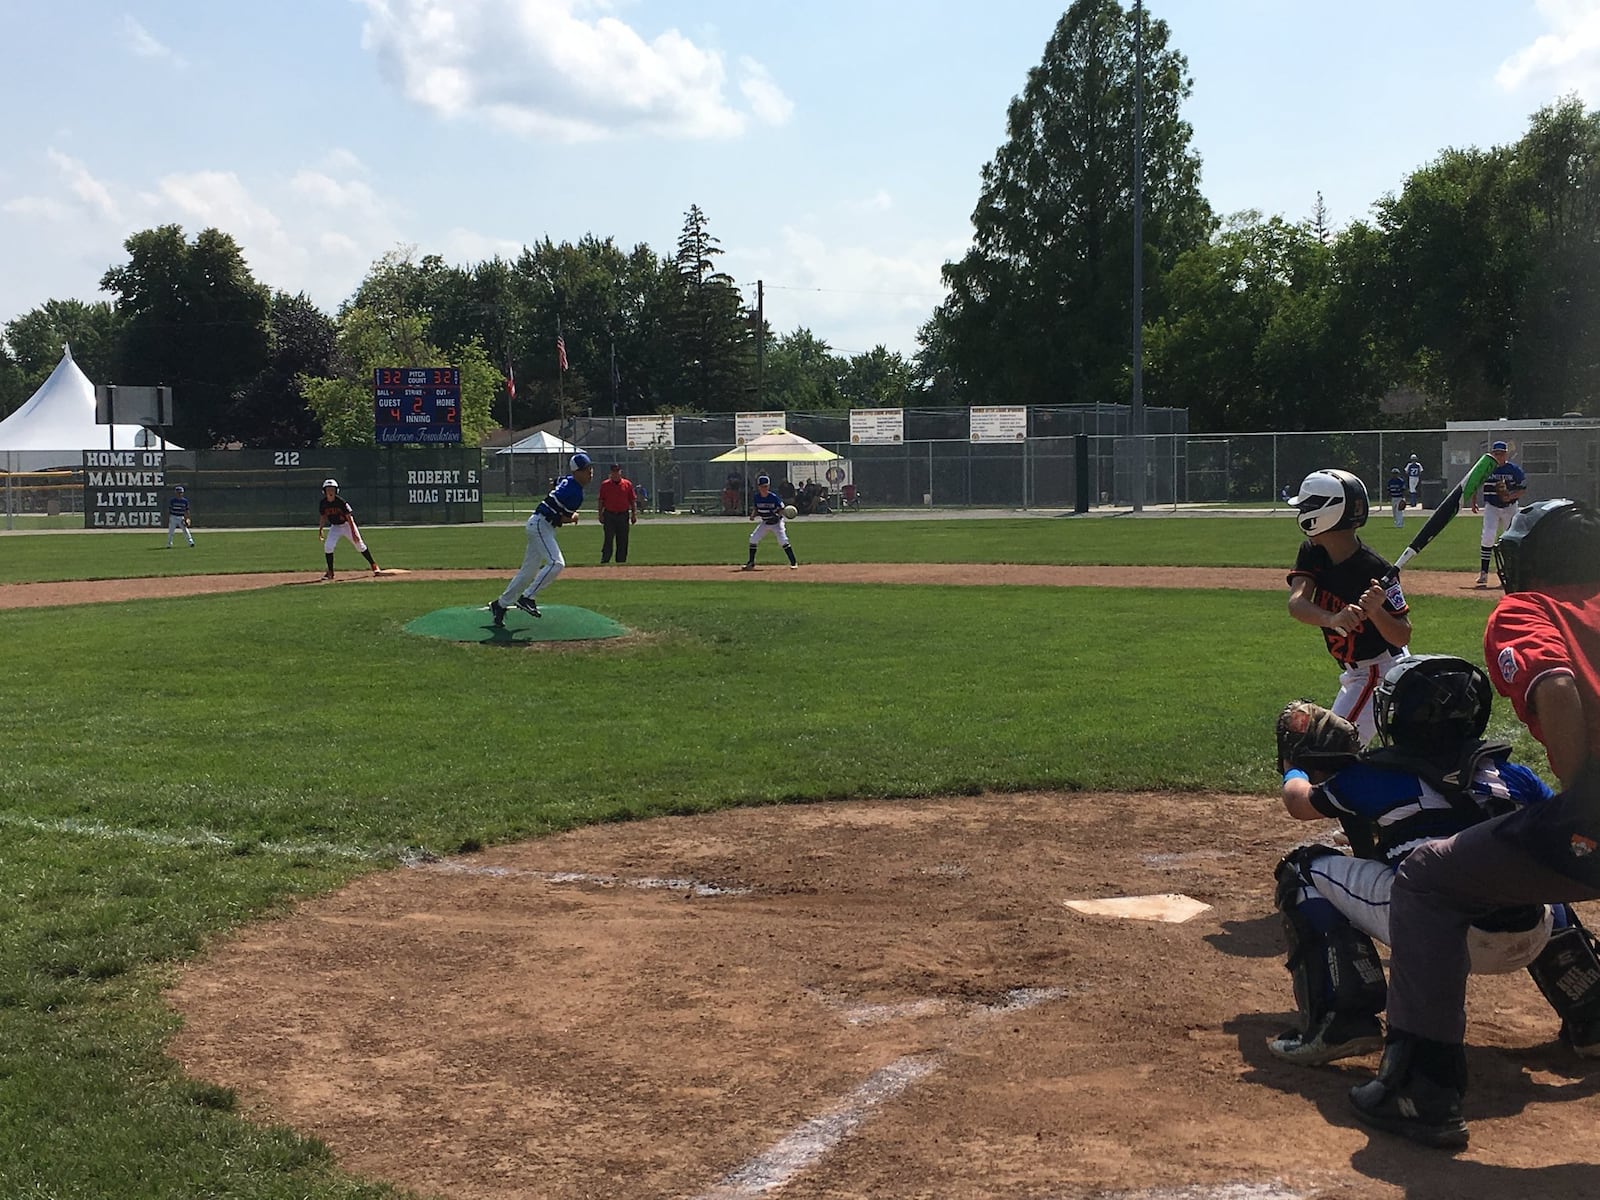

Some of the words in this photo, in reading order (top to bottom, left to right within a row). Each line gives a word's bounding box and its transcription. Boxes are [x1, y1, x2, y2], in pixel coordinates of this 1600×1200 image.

[383, 371, 400, 384] 32
[434, 371, 451, 384] 32
[379, 399, 401, 407] GUEST
[413, 397, 422, 412] 2
[436, 399, 455, 407] HOME
[390, 409, 400, 421] 4
[406, 415, 431, 423] INNING
[447, 408, 456, 422] 2
[416, 427, 459, 442] Foundation
[87, 452, 135, 467] HOME
[143, 452, 164, 467] OF
[274, 452, 300, 465] 212
[88, 472, 164, 486] MAUMEE
[407, 470, 460, 484] ROBERT
[468, 470, 479, 483] S.
[97, 492, 158, 507] LITTLE
[409, 489, 438, 503] HOAG
[445, 488, 479, 502] FIELD
[93, 511, 161, 526] LEAGUE
